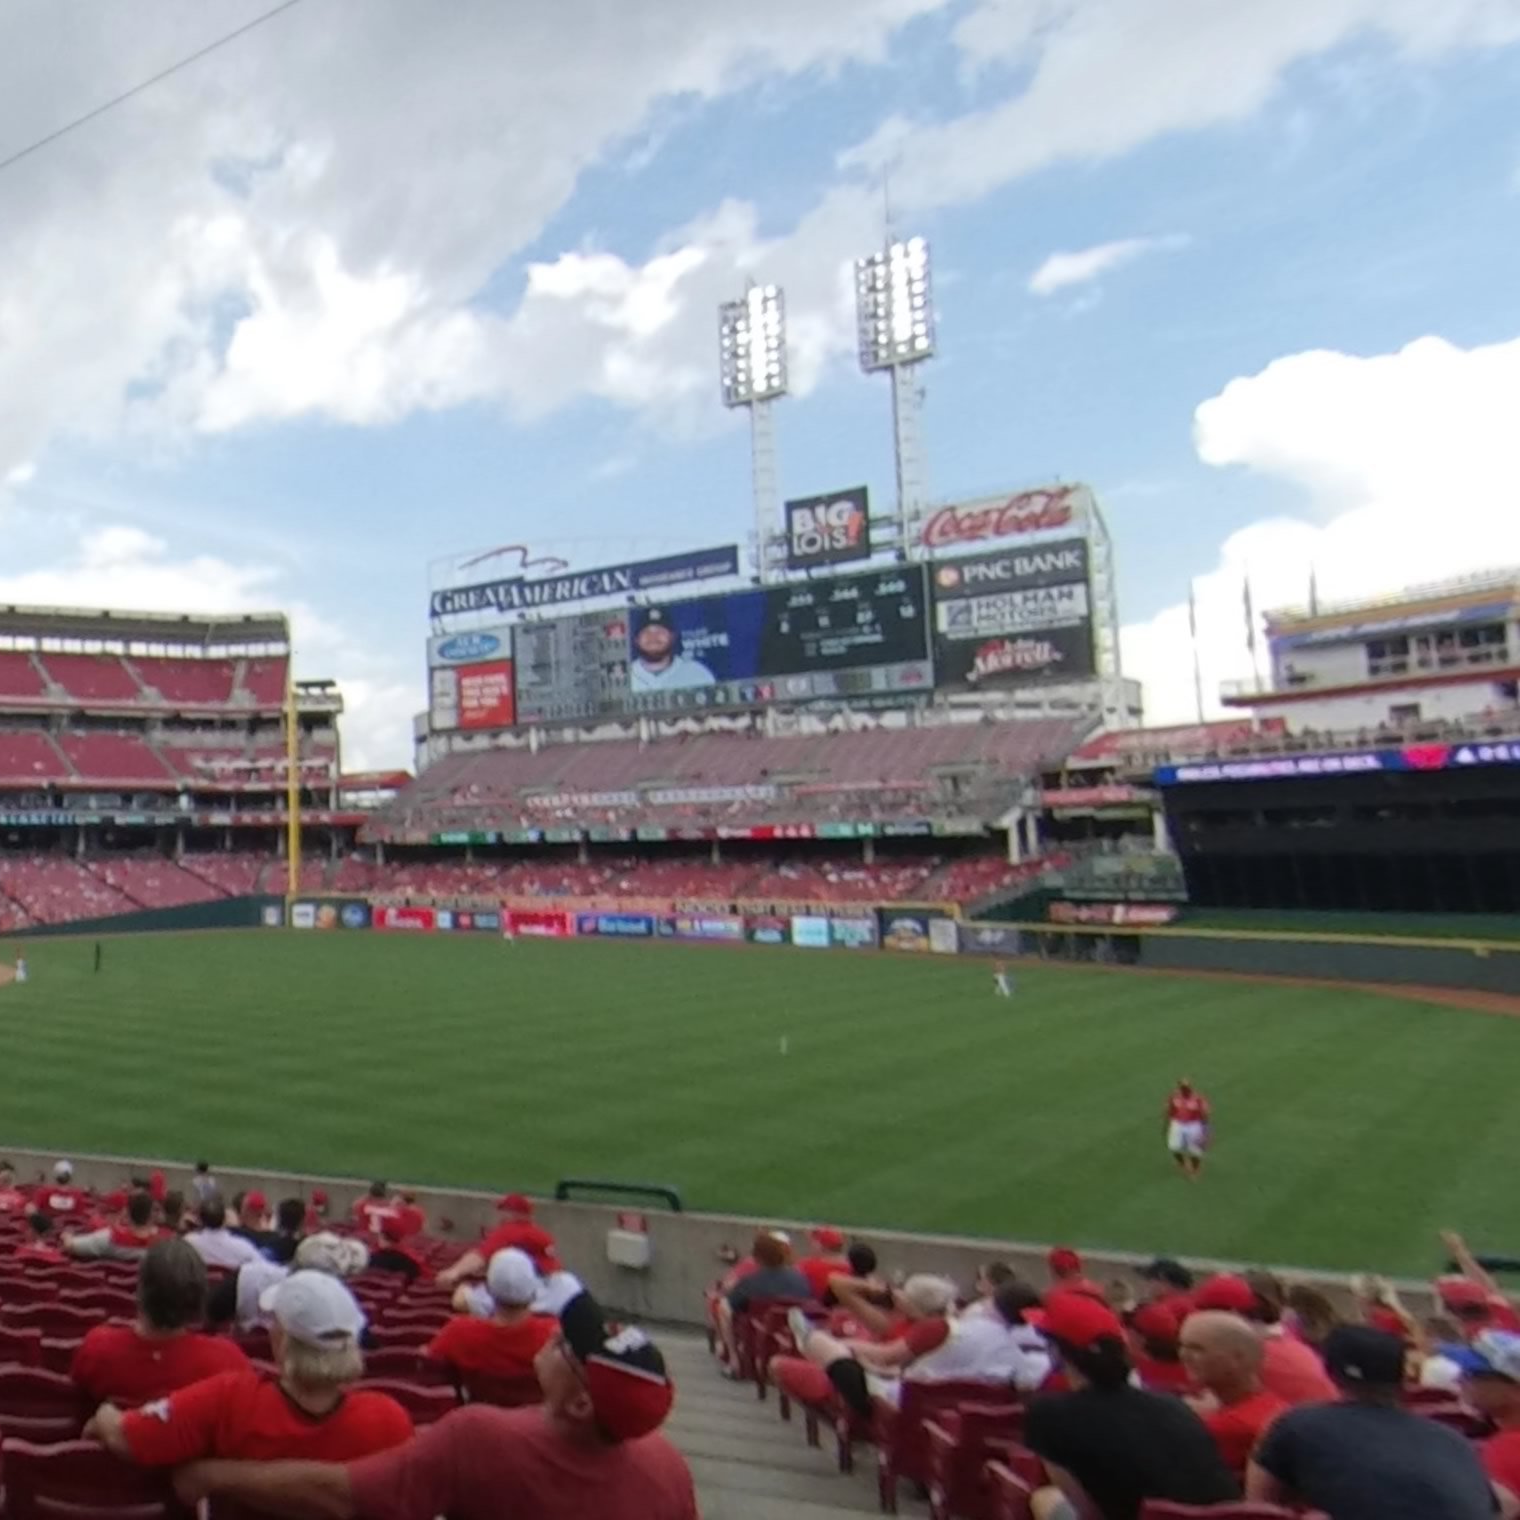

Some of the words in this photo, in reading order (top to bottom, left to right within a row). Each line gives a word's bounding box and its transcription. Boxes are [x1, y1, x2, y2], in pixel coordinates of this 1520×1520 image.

[791, 500, 853, 533] BIG
[923, 486, 1073, 547] Coca-Cola
[962, 560, 1010, 583] PNC
[1013, 550, 1081, 575] BANK
[502, 568, 631, 610] AMERICAN
